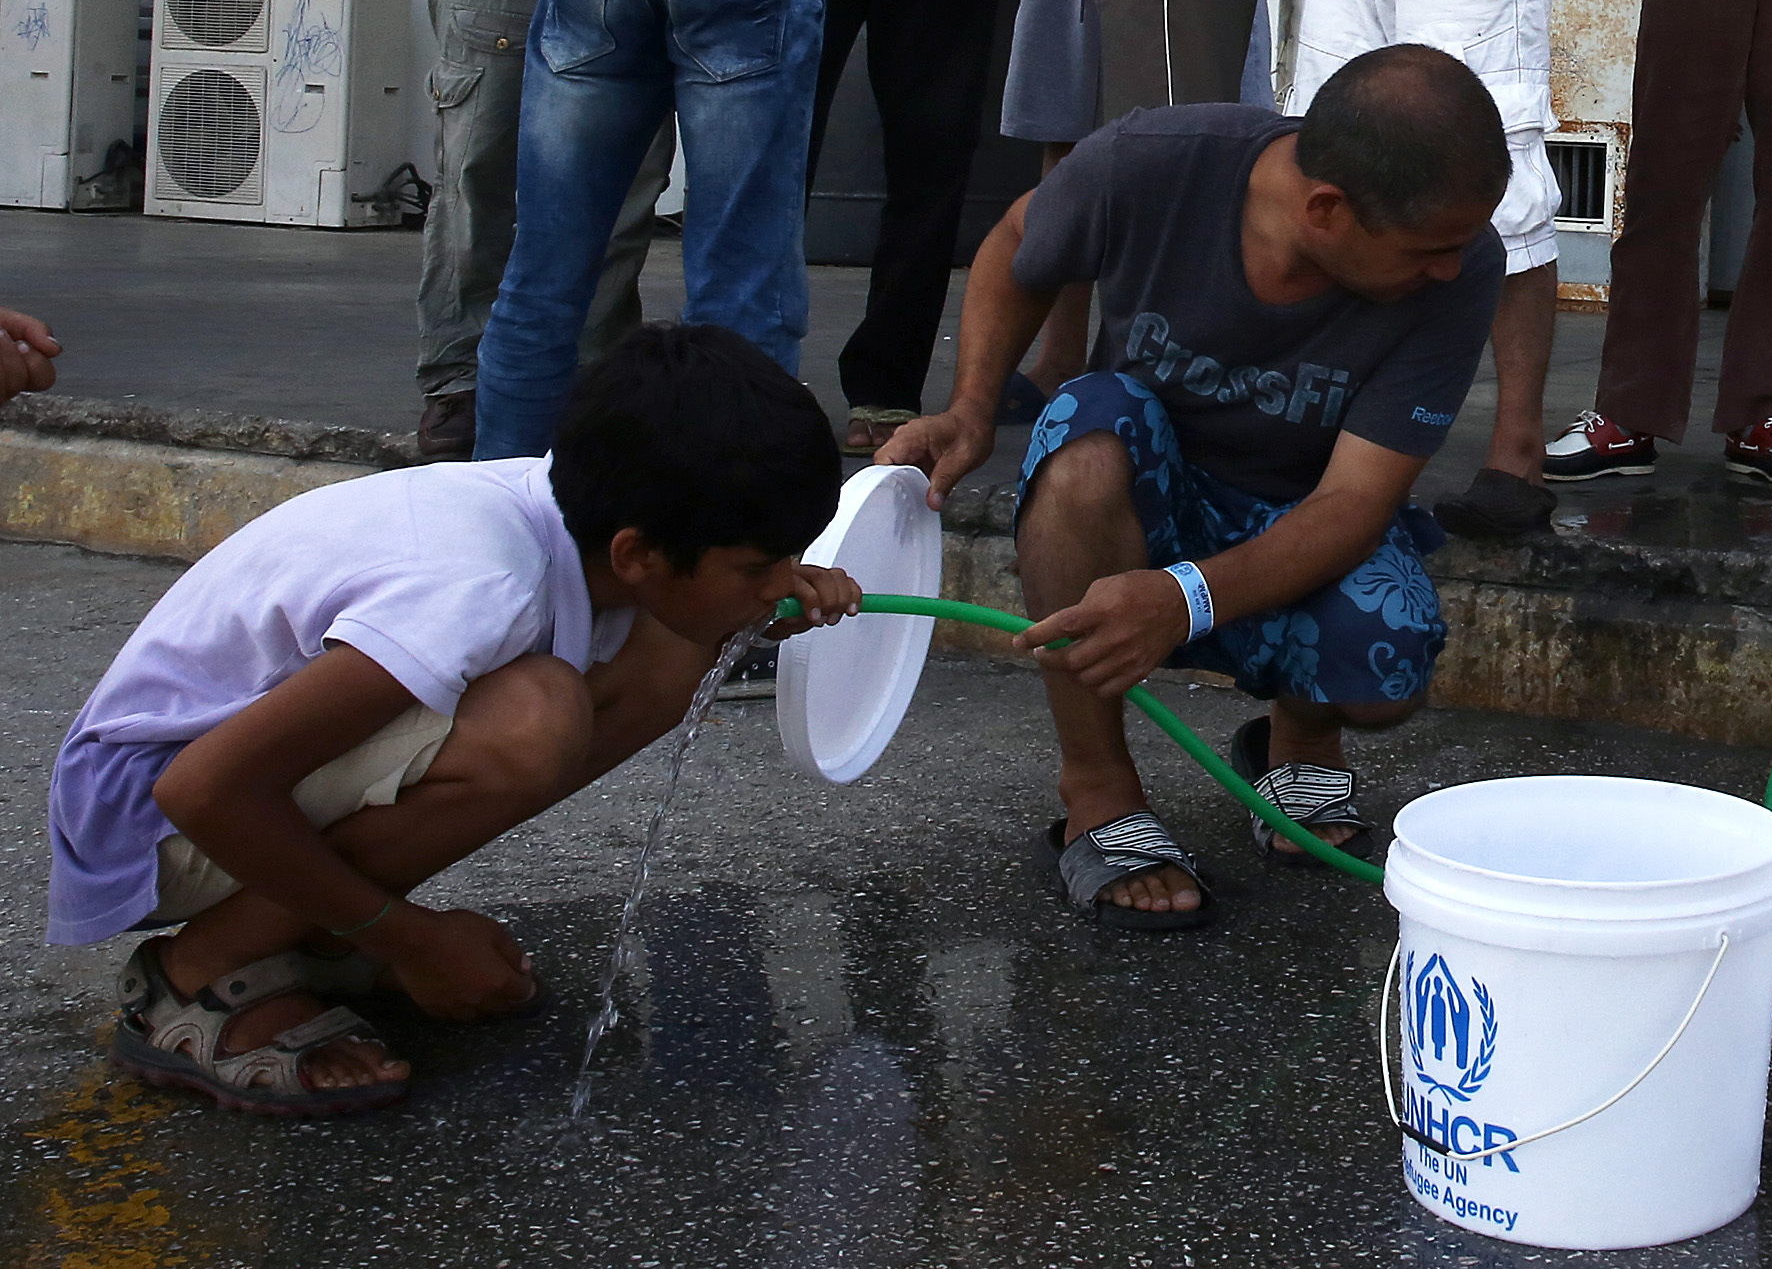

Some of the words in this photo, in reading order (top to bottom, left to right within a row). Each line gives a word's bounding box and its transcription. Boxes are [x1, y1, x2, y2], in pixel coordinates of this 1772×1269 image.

[1126, 311, 1354, 427] CrossFi
[1411, 405, 1454, 426] Reebo
[1402, 1080, 1521, 1174] UNHCR
[1443, 1158, 1468, 1187] UN
[1442, 1186, 1519, 1233] Agency
